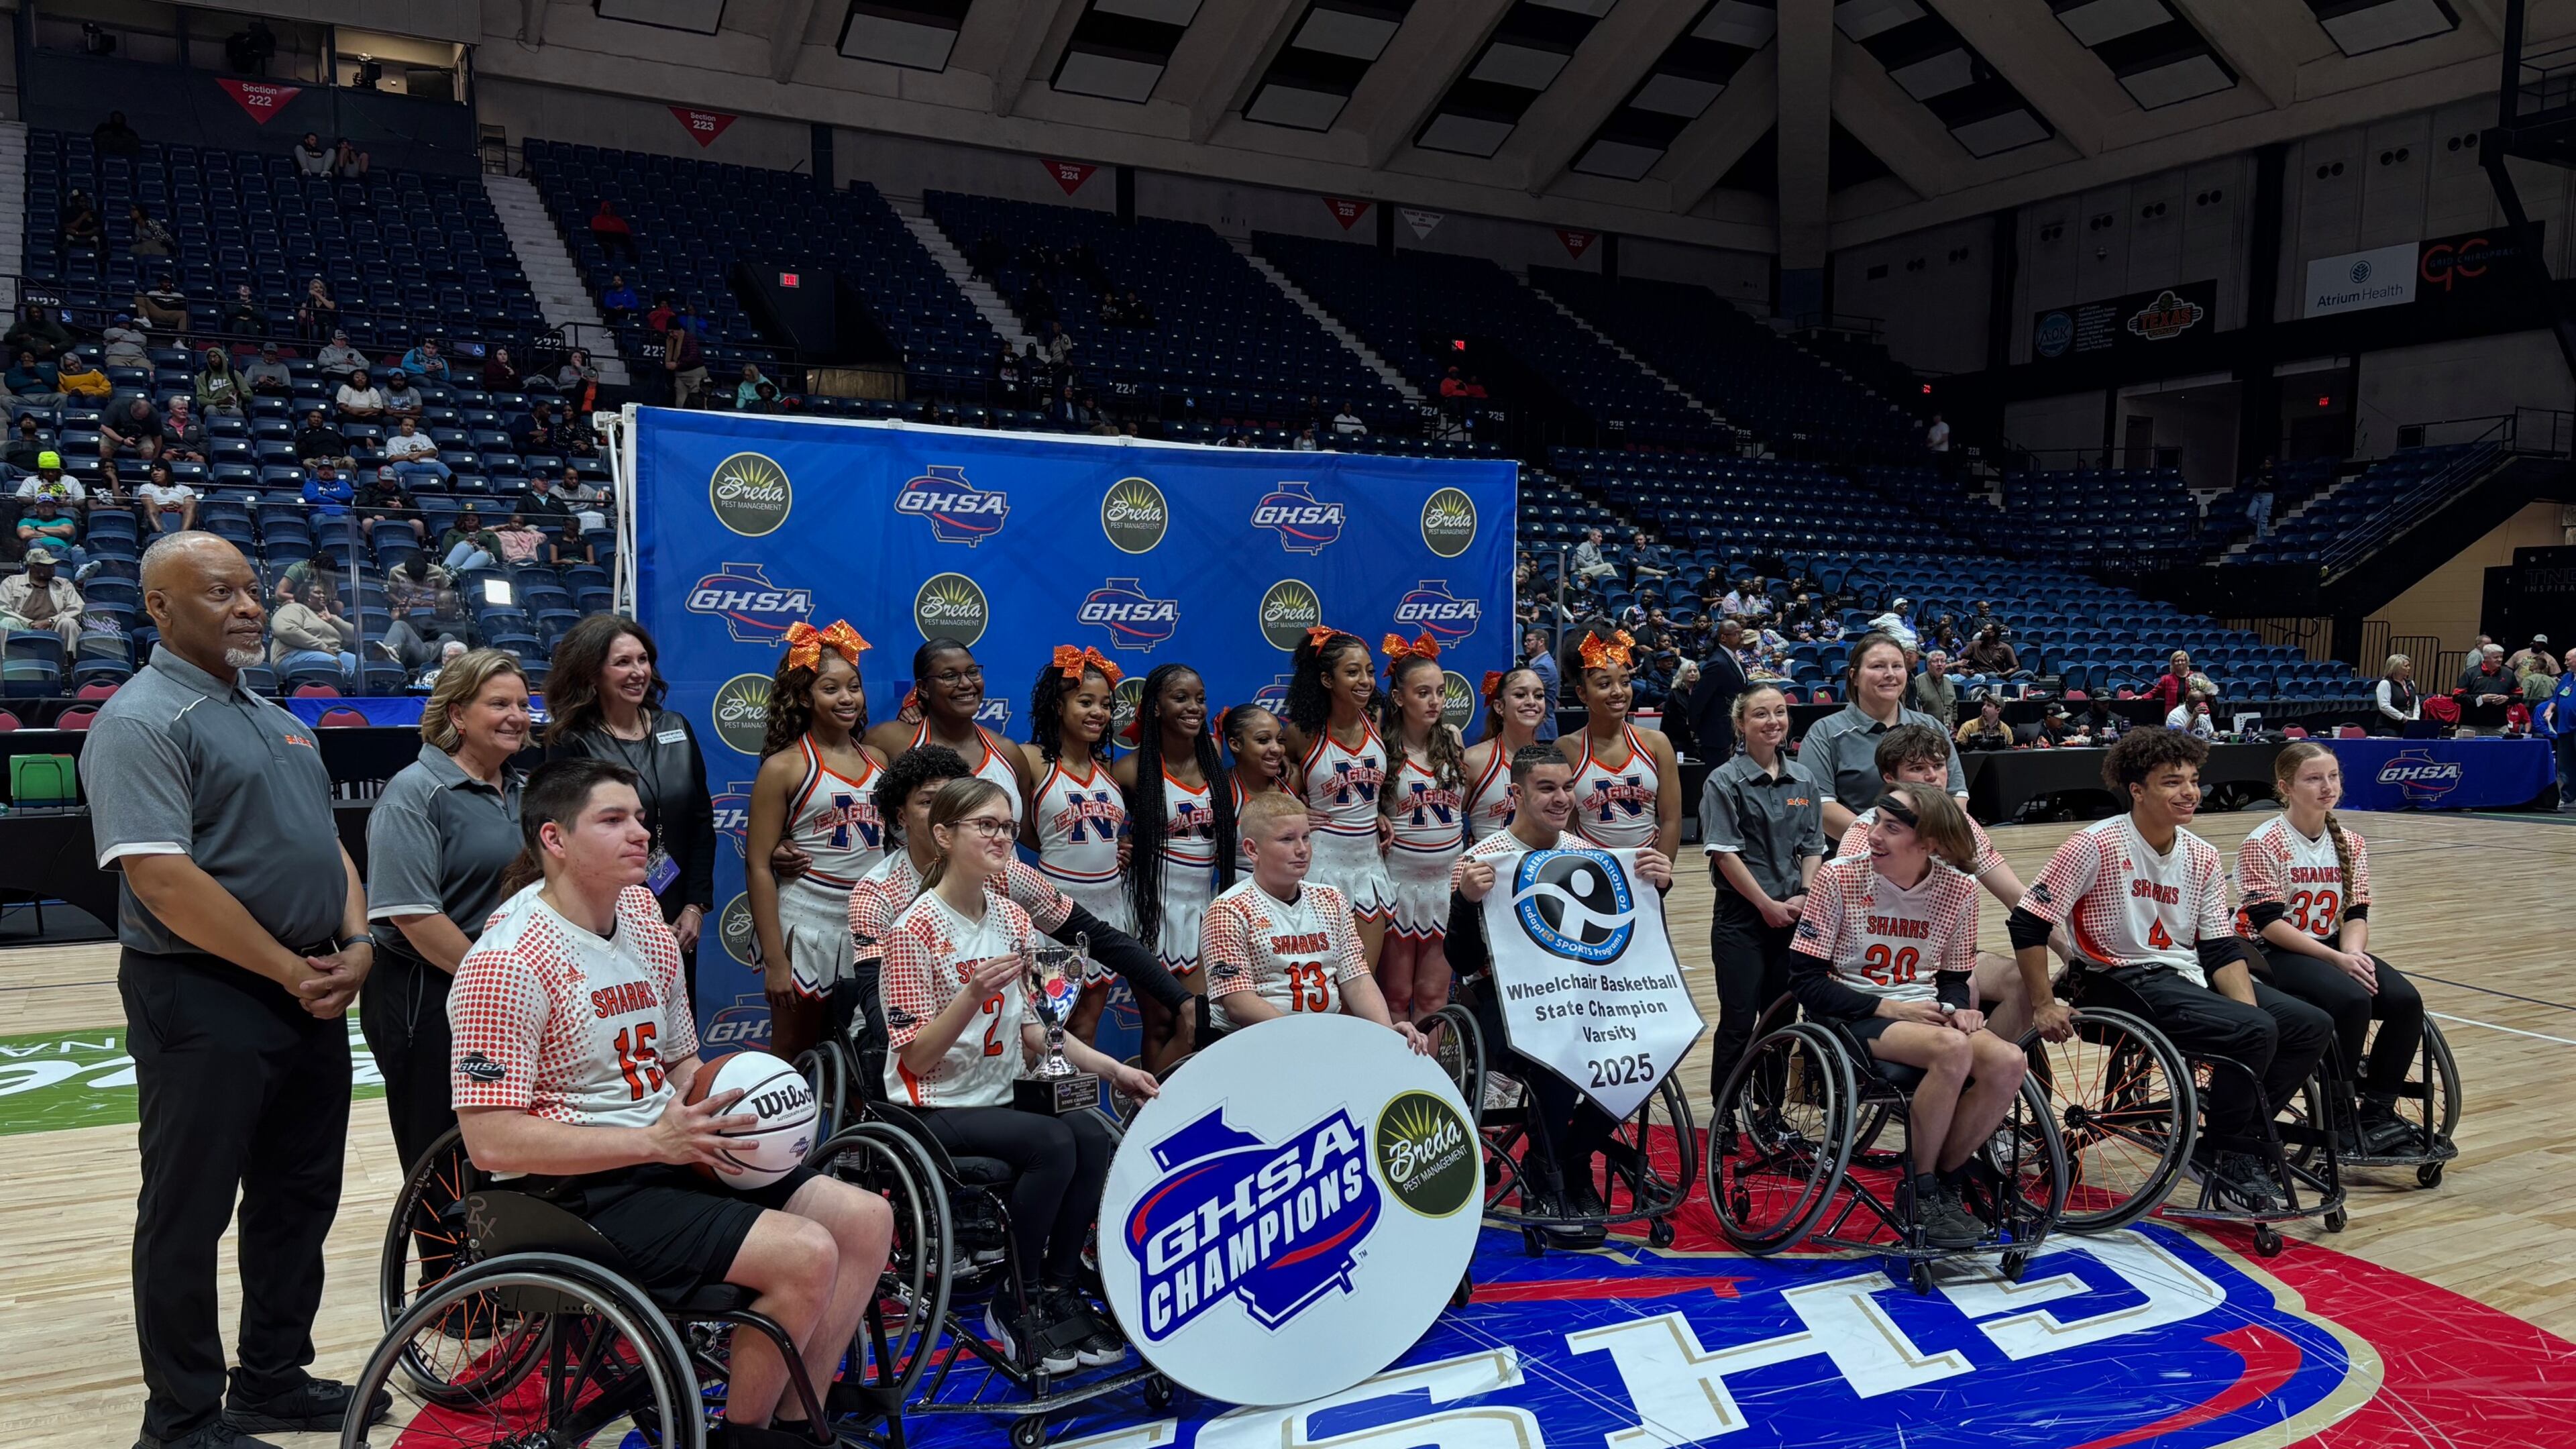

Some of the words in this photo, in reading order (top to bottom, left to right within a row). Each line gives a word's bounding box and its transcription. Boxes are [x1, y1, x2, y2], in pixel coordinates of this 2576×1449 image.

[242, 83, 277, 95] Section
[248, 95, 272, 106] 222
[690, 112, 716, 121] Section
[693, 120, 714, 131] 223
[1059, 164, 1081, 172] Section
[1061, 171, 1078, 180] 224
[1339, 208, 1354, 216] 225
[1569, 239, 1582, 247] 226
[2316, 293, 2360, 308] Atrium
[2362, 284, 2404, 301] Health
[2141, 308, 2190, 330] TEXAS
[1421, 406, 1438, 416] 224
[716, 476, 785, 502] Breda
[720, 500, 737, 508] PEST
[738, 501, 782, 511] MANAGEMENT
[898, 490, 1006, 515] GHSA
[1106, 499, 1163, 522] Breda
[1252, 504, 1342, 525] GHSA
[1425, 509, 1472, 528] Breda
[1124, 523, 1161, 531] MANAGEMENT
[688, 590, 808, 614] GHSA
[920, 596, 982, 619] Breda
[1079, 601, 1177, 622] GHSA
[1264, 600, 1316, 621] Breda
[1395, 602, 1479, 621] GHSA
[940, 619, 979, 627] MANAGEMENT
[720, 698, 769, 720] Bre
[2379, 765, 2458, 782] GHSA
[712, 808, 749, 828] GH
[1524, 850, 1561, 882] AMERICAN
[1618, 896, 1627, 910] OF
[2290, 866, 2342, 884] SHARKS
[2131, 878, 2180, 906] SHARKS
[2284, 890, 2339, 936] 33
[1524, 905, 1555, 943] adaptED
[1555, 938, 1593, 956] SPORTS
[1593, 933, 1623, 957] Programs
[1866, 915, 1930, 939] SHARKS
[2148, 915, 2173, 951] 4
[731, 936, 746, 944] PEST
[1271, 931, 1330, 955] SHARKS
[1861, 943, 1921, 985] 20
[1284, 960, 1330, 1013] 13
[1506, 973, 1598, 1001] Wheelchair
[1601, 974, 1678, 992] Basketball
[591, 979, 659, 1019] SHARKS
[888, 1013, 917, 1022] HSA
[1536, 1000, 1584, 1022] State
[1589, 1000, 1668, 1019] Champion
[706, 1018, 771, 1044] GH
[983, 991, 1006, 1057] 2
[1582, 1025, 1638, 1044] Varsity
[458, 1062, 507, 1073] GHSA
[613, 1021, 663, 1102] 15
[1587, 1053, 1656, 1089] 2025
[1389, 1117, 1462, 1183] Breda
[1403, 1173, 1424, 1194] PEST
[1420, 1145, 1468, 1184] MANAGEMENT
[1146, 1118, 1360, 1277] GHSA
[1148, 1156, 1363, 1334] CHAMPIONS
[1358, 1250, 1368, 1259] TM
